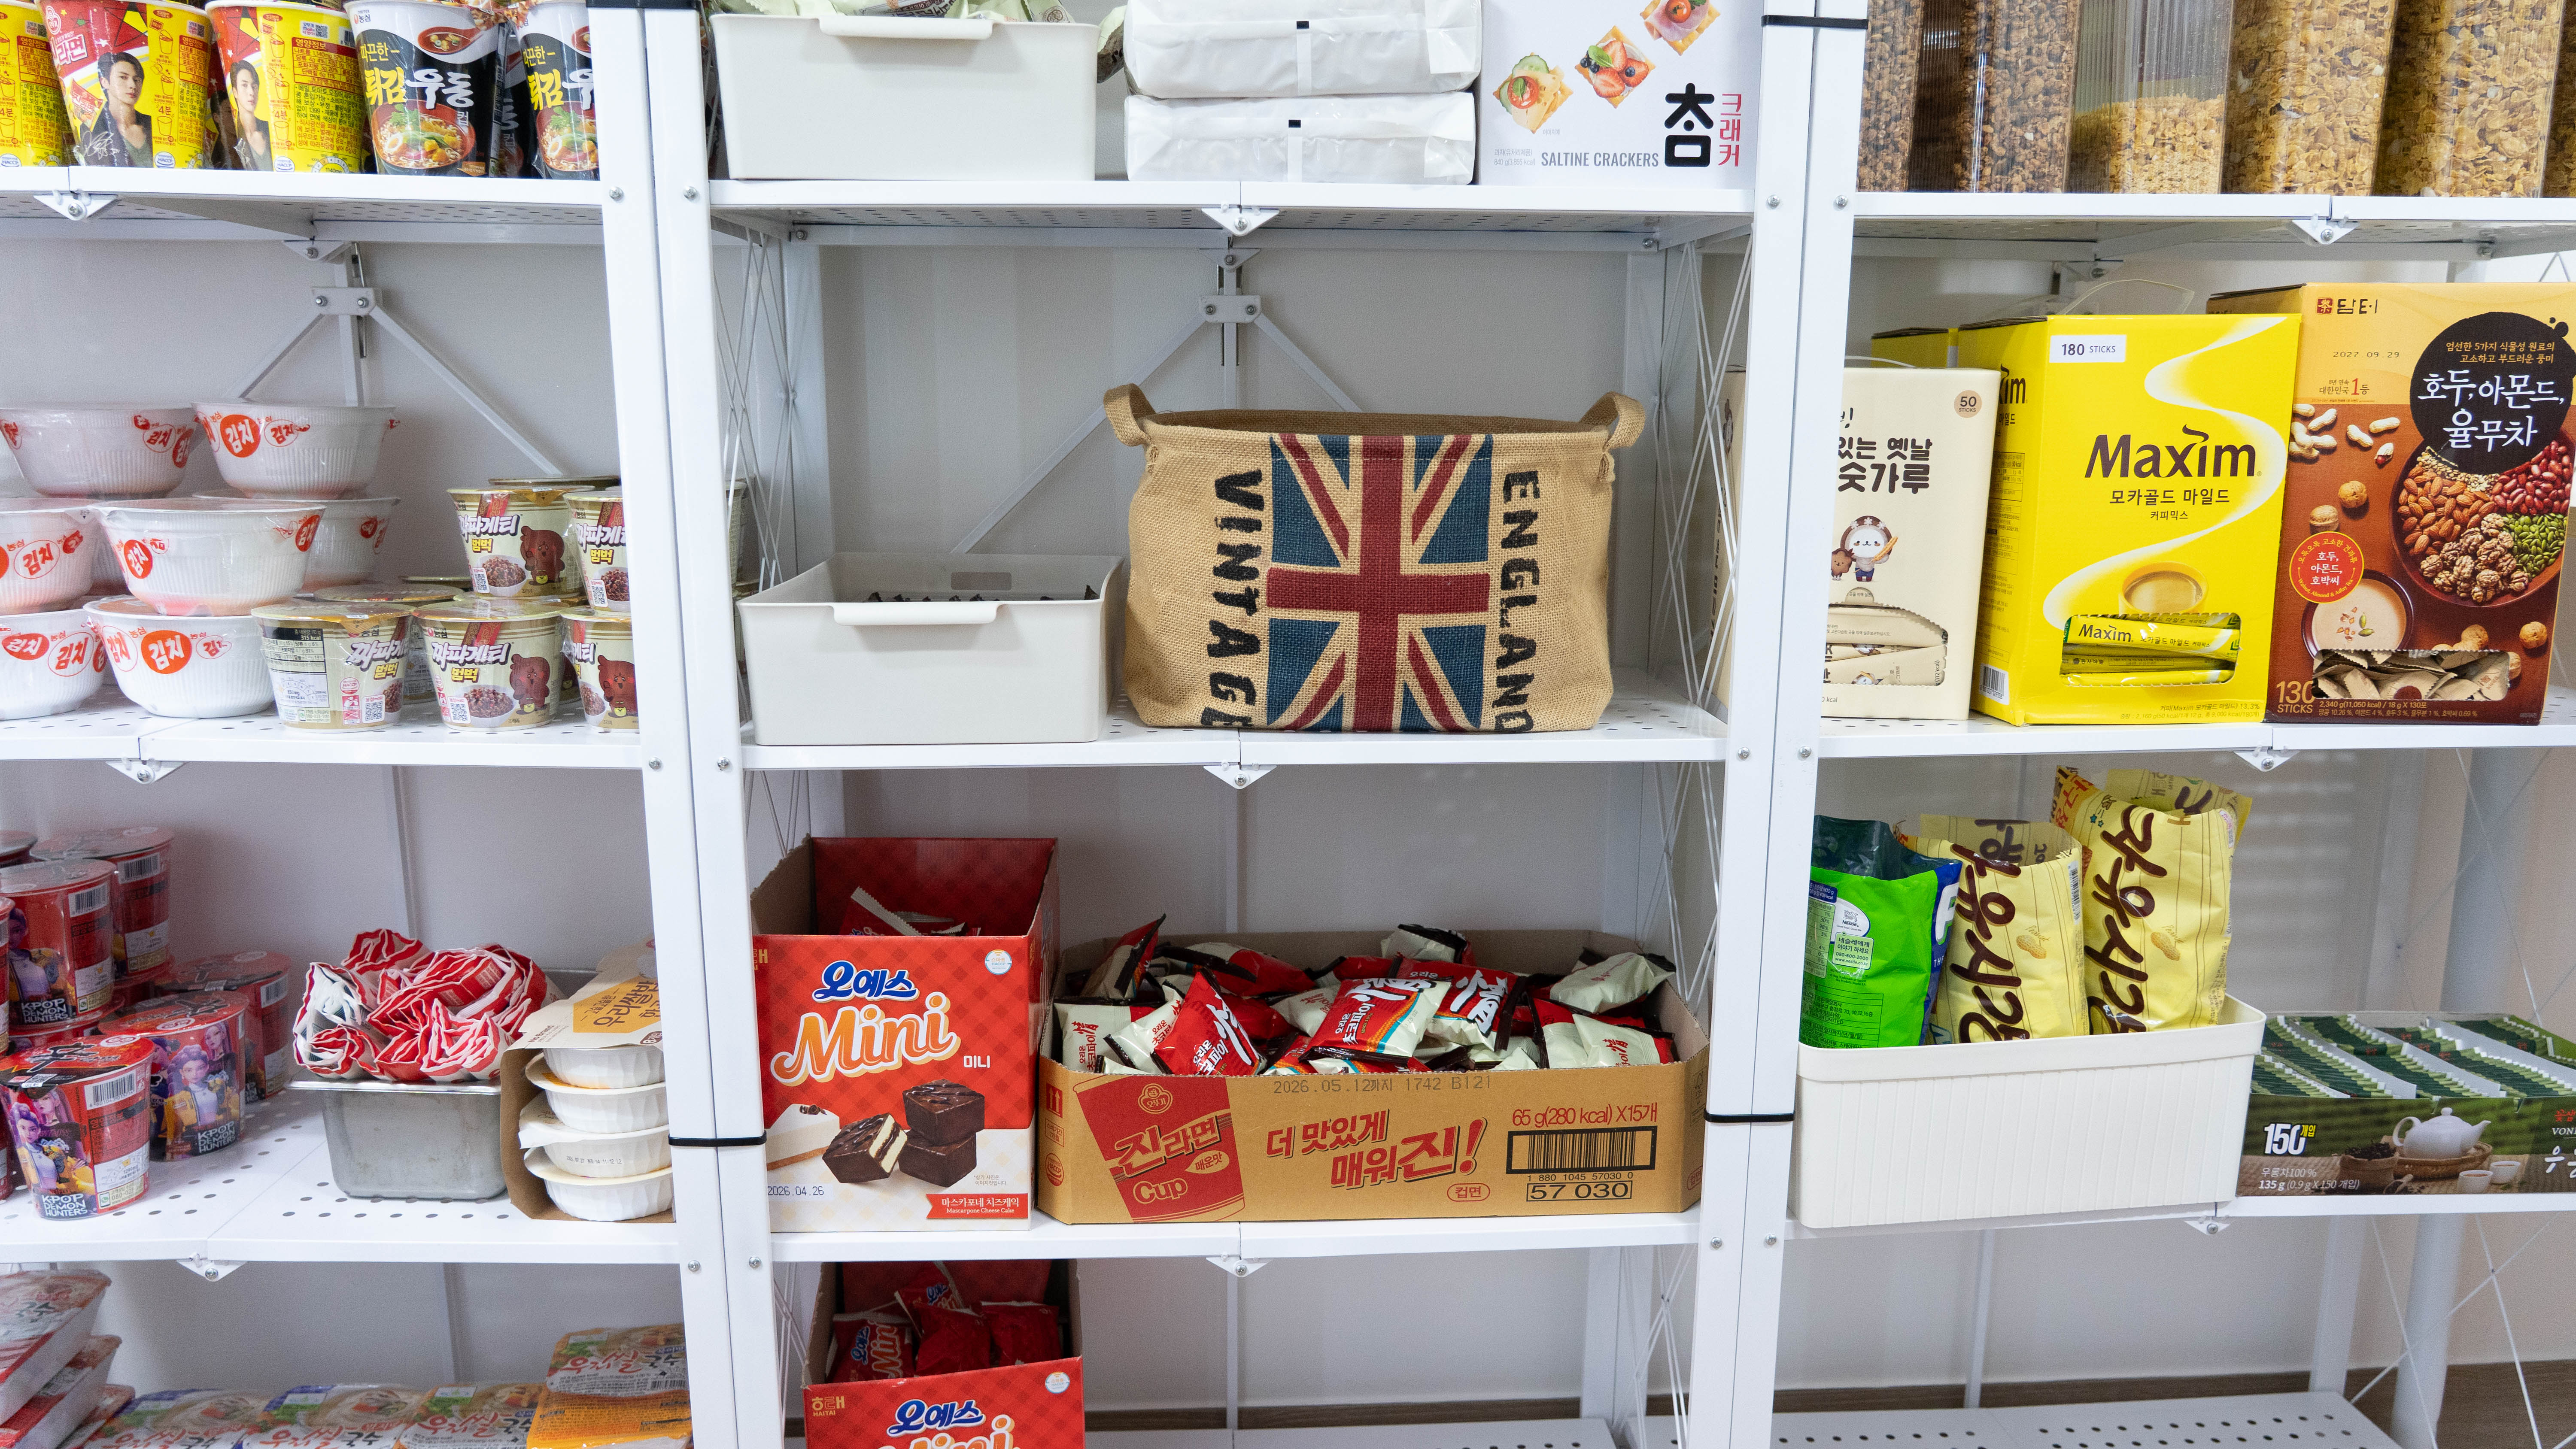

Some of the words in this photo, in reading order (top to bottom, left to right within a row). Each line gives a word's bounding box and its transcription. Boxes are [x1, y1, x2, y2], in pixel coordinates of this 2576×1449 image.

[295, 39, 327, 50] 영양정보
[158, 106, 171, 115] 4분
[274, 110, 288, 120] 4분
[456, 111, 469, 126] 컵
[1718, 93, 1742, 167] 크래커
[1541, 152, 1590, 167] SALTINE
[1593, 152, 1659, 167] CRACKERS
[2337, 298, 2378, 315] 담터
[2061, 343, 2085, 356] 180
[2089, 345, 2117, 355] STICKS
[2446, 342, 2473, 352] 엄선한
[2474, 342, 2497, 352] 5가지
[2499, 342, 2526, 352] 식물성
[2527, 341, 2555, 352] 원료의
[2459, 354, 2496, 364] 고소하고
[2498, 354, 2534, 364] 부드러운
[2536, 354, 2554, 364] 풍미
[2319, 386, 2350, 395] 대한민국
[1959, 395, 1978, 408] 50
[146, 429, 172, 448] 김치
[225, 418, 255, 453] 김치
[270, 422, 295, 444] 김치
[2442, 408, 2538, 452] 율무차
[1886, 437, 1933, 461] 옛날
[2084, 424, 2257, 479] Maxim
[1838, 462, 1931, 495] 숫가루
[2109, 488, 2177, 506] 모카골드
[2183, 488, 2230, 505] 마일드
[2149, 509, 2189, 521] 커피믹스
[471, 537, 494, 553] 범벅
[2298, 540, 2321, 564] 오독오독
[2322, 538, 2344, 548] 고소한
[2342, 544, 2358, 564] 견과류
[23, 542, 55, 576] 김치
[128, 542, 149, 576] 김치
[589, 549, 614, 564] 범벅
[2316, 551, 2339, 562] 호두,
[2310, 563, 2343, 574] 아몬드,
[2310, 575, 2340, 586] 호박씨
[1201, 469, 1265, 730] VINTAGE
[1494, 470, 1541, 734] ENGLAND
[2078, 623, 2132, 643] Maxim
[2169, 638, 2190, 646] 마일드
[9, 637, 42, 656] 김치
[55, 636, 89, 670] 김치
[149, 634, 185, 671] 김치
[431, 642, 512, 672] 짜파게티
[374, 661, 399, 680] 범벅
[451, 667, 480, 683] 범벅
[2275, 680, 2315, 703] 130
[2277, 704, 2313, 714] STICKS
[1838, 937, 1870, 948] 네슬레에게
[1854, 946, 1869, 955] 하세요
[1835, 952, 1869, 961] 080-600-2000
[1835, 957, 1868, 966] www.nestle.co.kr
[813, 960, 918, 1001] 오예스
[23, 1007, 67, 1018] DEMON
[24, 1013, 69, 1024] HUNTERS
[1151, 1019, 1168, 1035] 오리온
[1335, 1012, 1352, 1034] 오리온
[1343, 1001, 1376, 1046] 초코파이
[771, 991, 961, 1086] Mini
[963, 1054, 991, 1070] 미니
[1193, 1039, 1213, 1067] 오리온
[1273, 1078, 1393, 1094] 2026.05.12까지
[1404, 1077, 1441, 1091] 1742
[1451, 1075, 1492, 1090] B121
[1146, 1098, 1167, 1108] 오뚜기
[1512, 1109, 1532, 1126] 65
[1534, 1106, 1577, 1128] g(280
[1579, 1104, 1613, 1124] kcal)
[1616, 1102, 1658, 1123] X15개
[198, 1127, 235, 1146] DEMON
[1265, 1123, 1297, 1159] 더
[1300, 1109, 1390, 1155] 맛있게
[2264, 1123, 2306, 1155] 150
[2300, 1125, 2316, 1137] 개입
[199, 1136, 236, 1154] HUNTERS
[1116, 1112, 1224, 1178] 진라면
[1330, 1116, 1489, 1190] 매워진!
[1047, 1163, 1062, 1175] HACCP
[1194, 1152, 1223, 1172] 매운맛
[767, 1185, 825, 1197] 2026.04.26
[1133, 1177, 1188, 1204] Cup
[1454, 1185, 1482, 1199] 컵면
[1529, 1183, 1565, 1200] 57
[1574, 1182, 1629, 1199] 030
[2258, 1180, 2277, 1189] 135
[2278, 1182, 2286, 1191] g
[2287, 1180, 2304, 1190] (0.9
[2321, 1180, 2336, 1189] 150
[2338, 1179, 2360, 1190] 개입)
[44, 1200, 86, 1211] DEMON
[942, 1197, 984, 1208] 마스카포네
[986, 1197, 1019, 1208] 치즈케익
[45, 1207, 88, 1217] HUNTERS
[887, 1399, 987, 1437] 오예스
